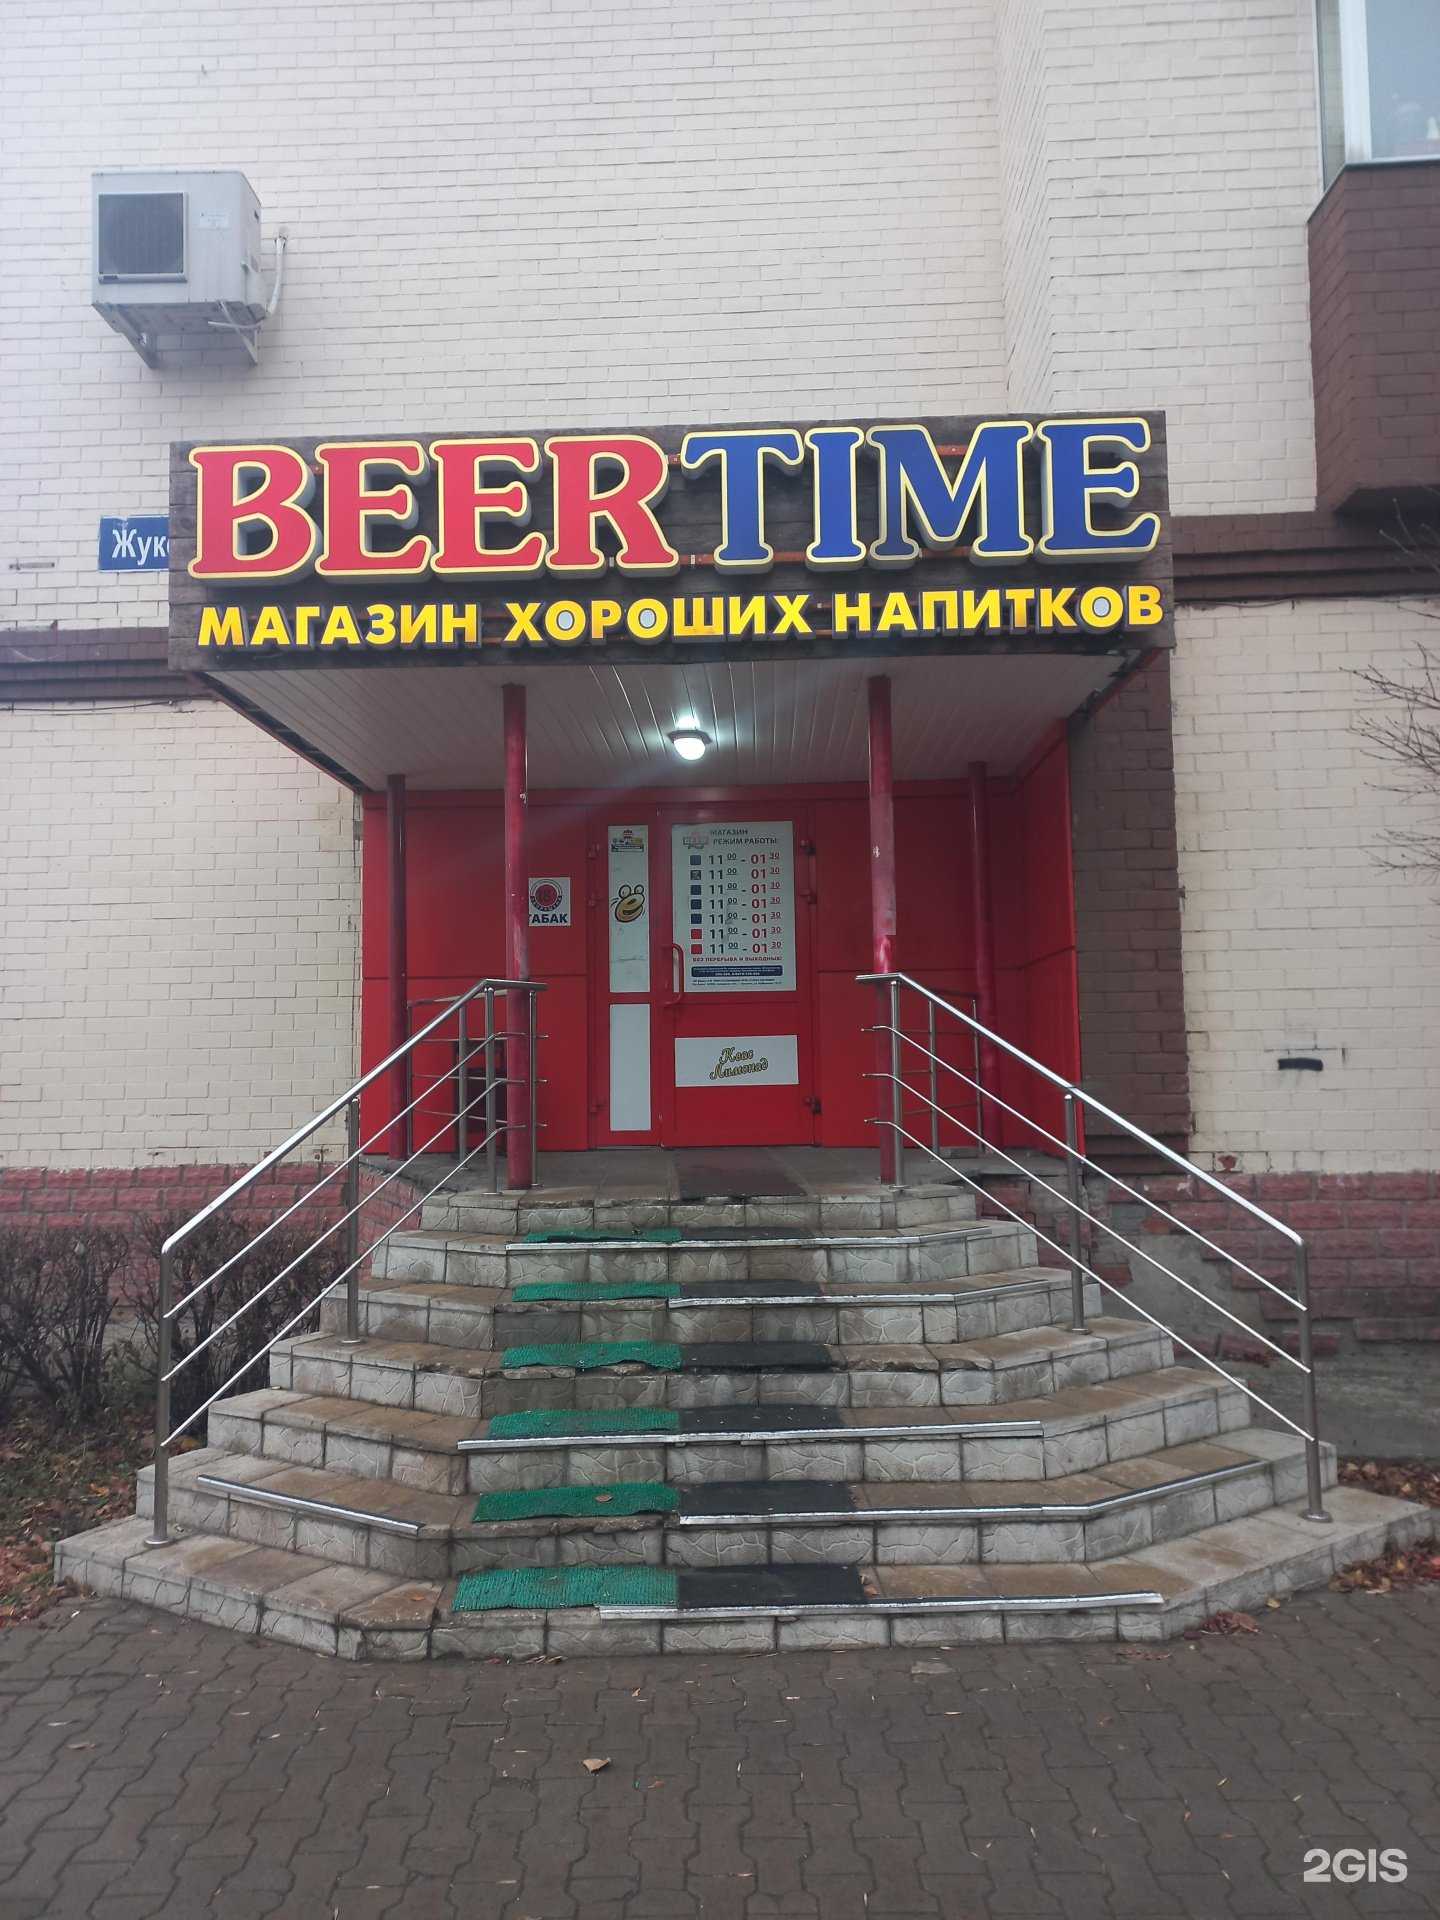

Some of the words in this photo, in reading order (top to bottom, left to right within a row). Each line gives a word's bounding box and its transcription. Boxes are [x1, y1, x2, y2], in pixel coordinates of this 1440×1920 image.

[188, 434, 680, 580] BEER
[681, 417, 1162, 567] TIME
[111, 528, 169, 566] Жук
[197, 602, 480, 647] МАГАЗИН
[503, 593, 814, 643] ХОРОШИХ
[834, 584, 1164, 634] НАПИТКОВ
[710, 828, 748, 836] МАГАЗИН
[708, 854, 723, 864] 11
[750, 854, 767, 864] 01
[708, 869, 724, 880] 11
[751, 868, 767, 879] 01
[709, 884, 724, 895] 11
[751, 883, 767, 894] 01
[709, 899, 724, 909] 11
[752, 898, 767, 909] 01
[709, 914, 724, 924] 11
[752, 913, 767, 923] 01
[770, 911, 781, 919] 30
[710, 928, 724, 939] 11
[752, 928, 767, 939] 01
[771, 926, 781, 934] 30
[710, 943, 724, 954] 11
[752, 943, 767, 953] 01
[771, 941, 782, 949] 30
[719, 1046, 753, 1064] Квас
[709, 1057, 768, 1080] Лимонад
